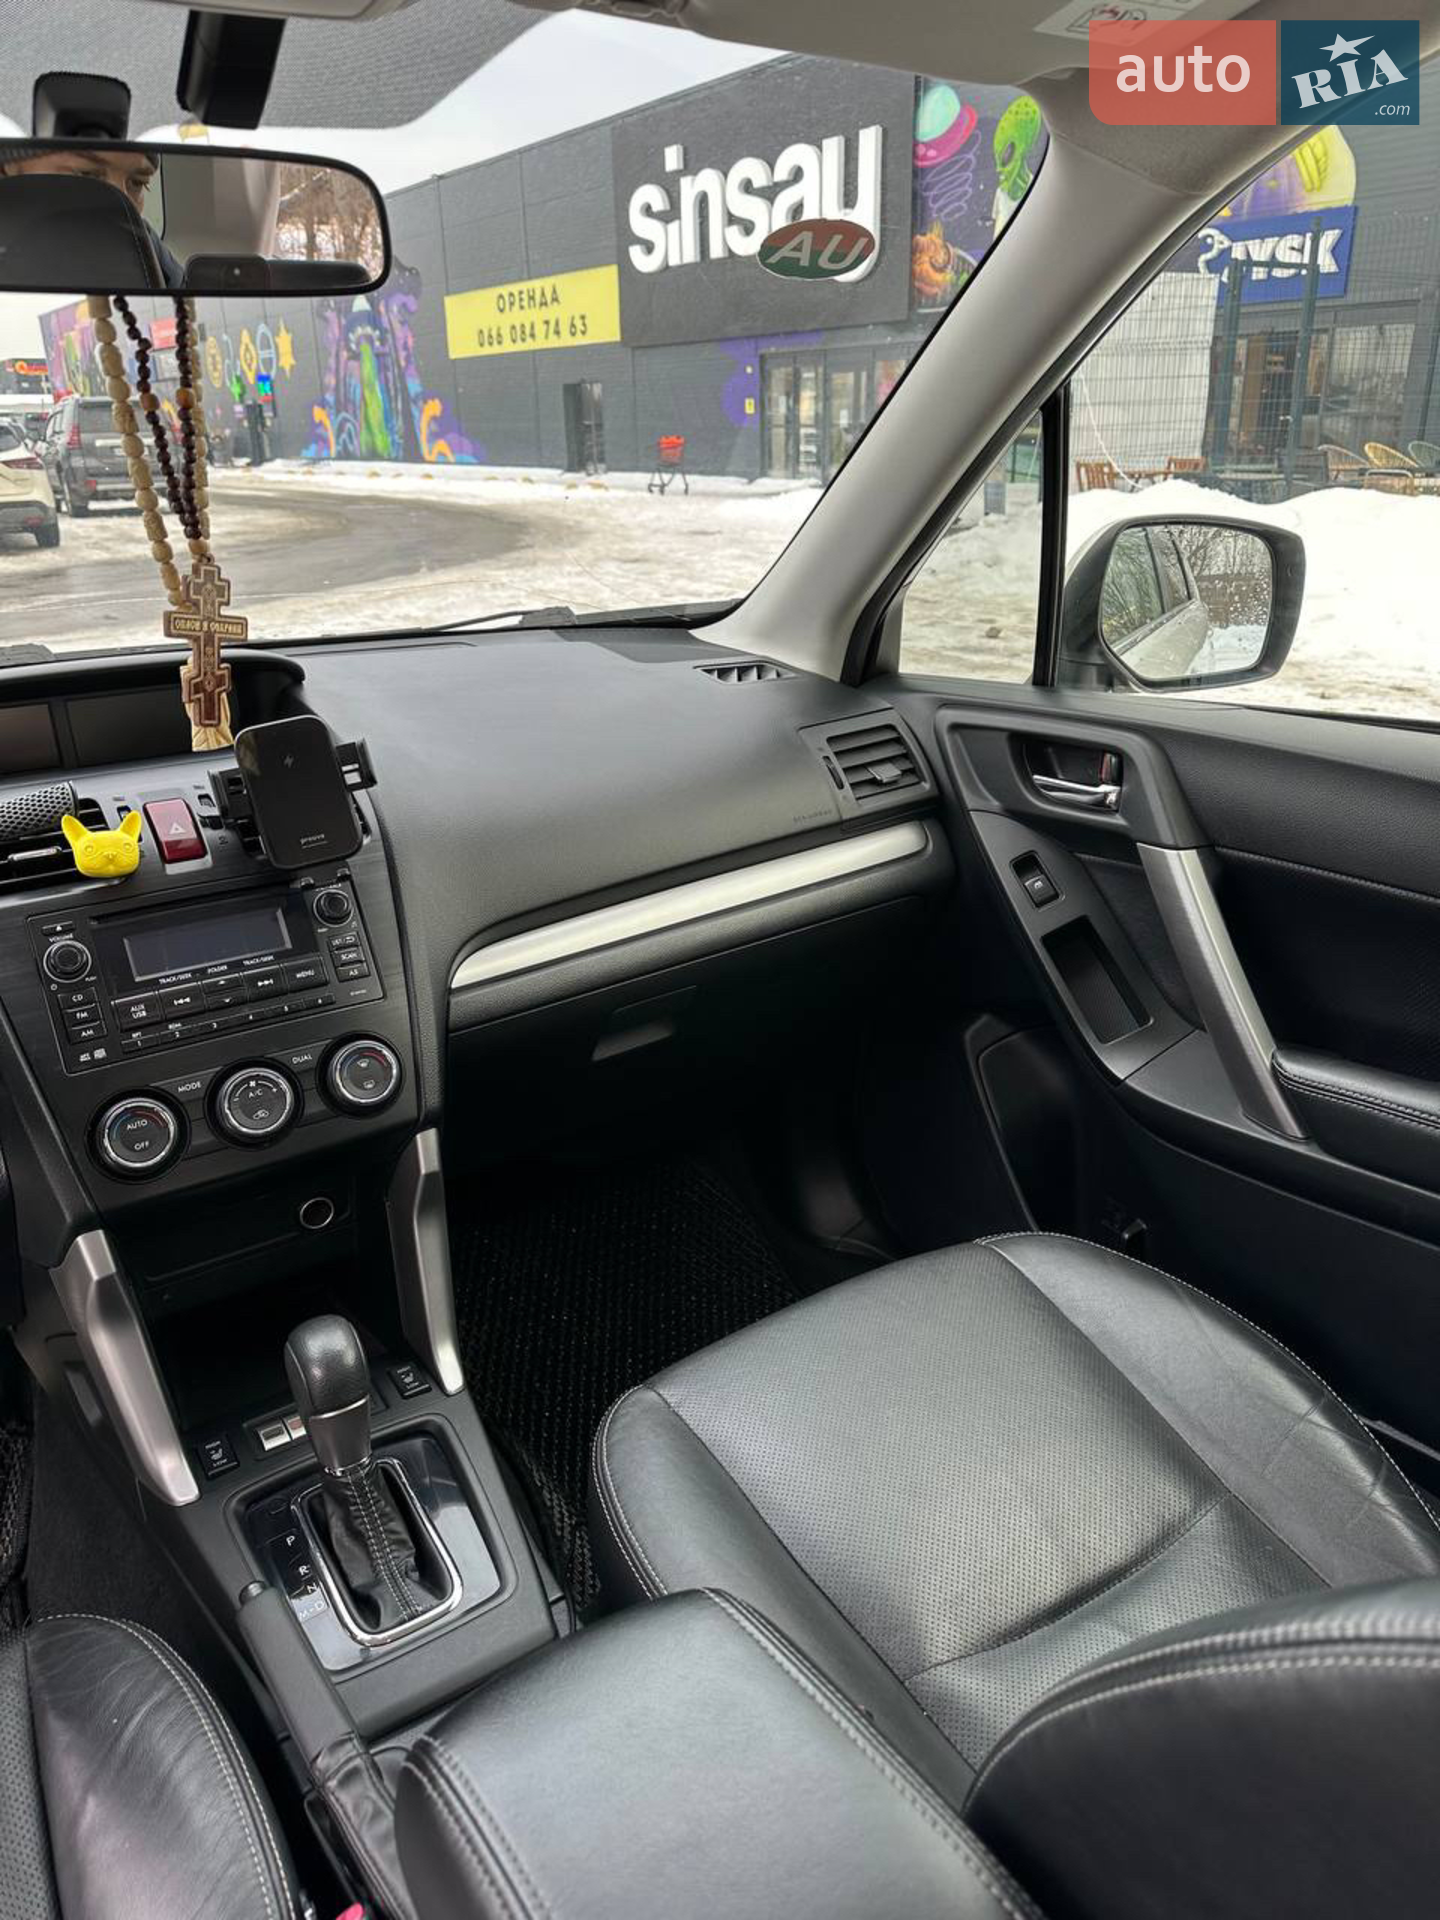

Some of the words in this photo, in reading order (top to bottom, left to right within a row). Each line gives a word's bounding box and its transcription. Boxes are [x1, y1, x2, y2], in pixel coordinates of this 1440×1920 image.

[496, 283, 561, 314] ОРЕНДА
[477, 326, 504, 348] 066
[509, 320, 536, 345] 084
[542, 317, 562, 340] 74
[568, 314, 588, 337] 63
[71, 993, 84, 1003] CD
[80, 1028, 94, 1038] AM
[292, 1053, 313, 1065] DUAL
[177, 1080, 202, 1093] MODE
[248, 1088, 264, 1098] A/C
[126, 1118, 149, 1131] AUTO
[134, 1140, 150, 1151] OFF
[286, 1535, 295, 1547] P
[299, 1565, 309, 1576] R
[306, 1581, 318, 1594] N
